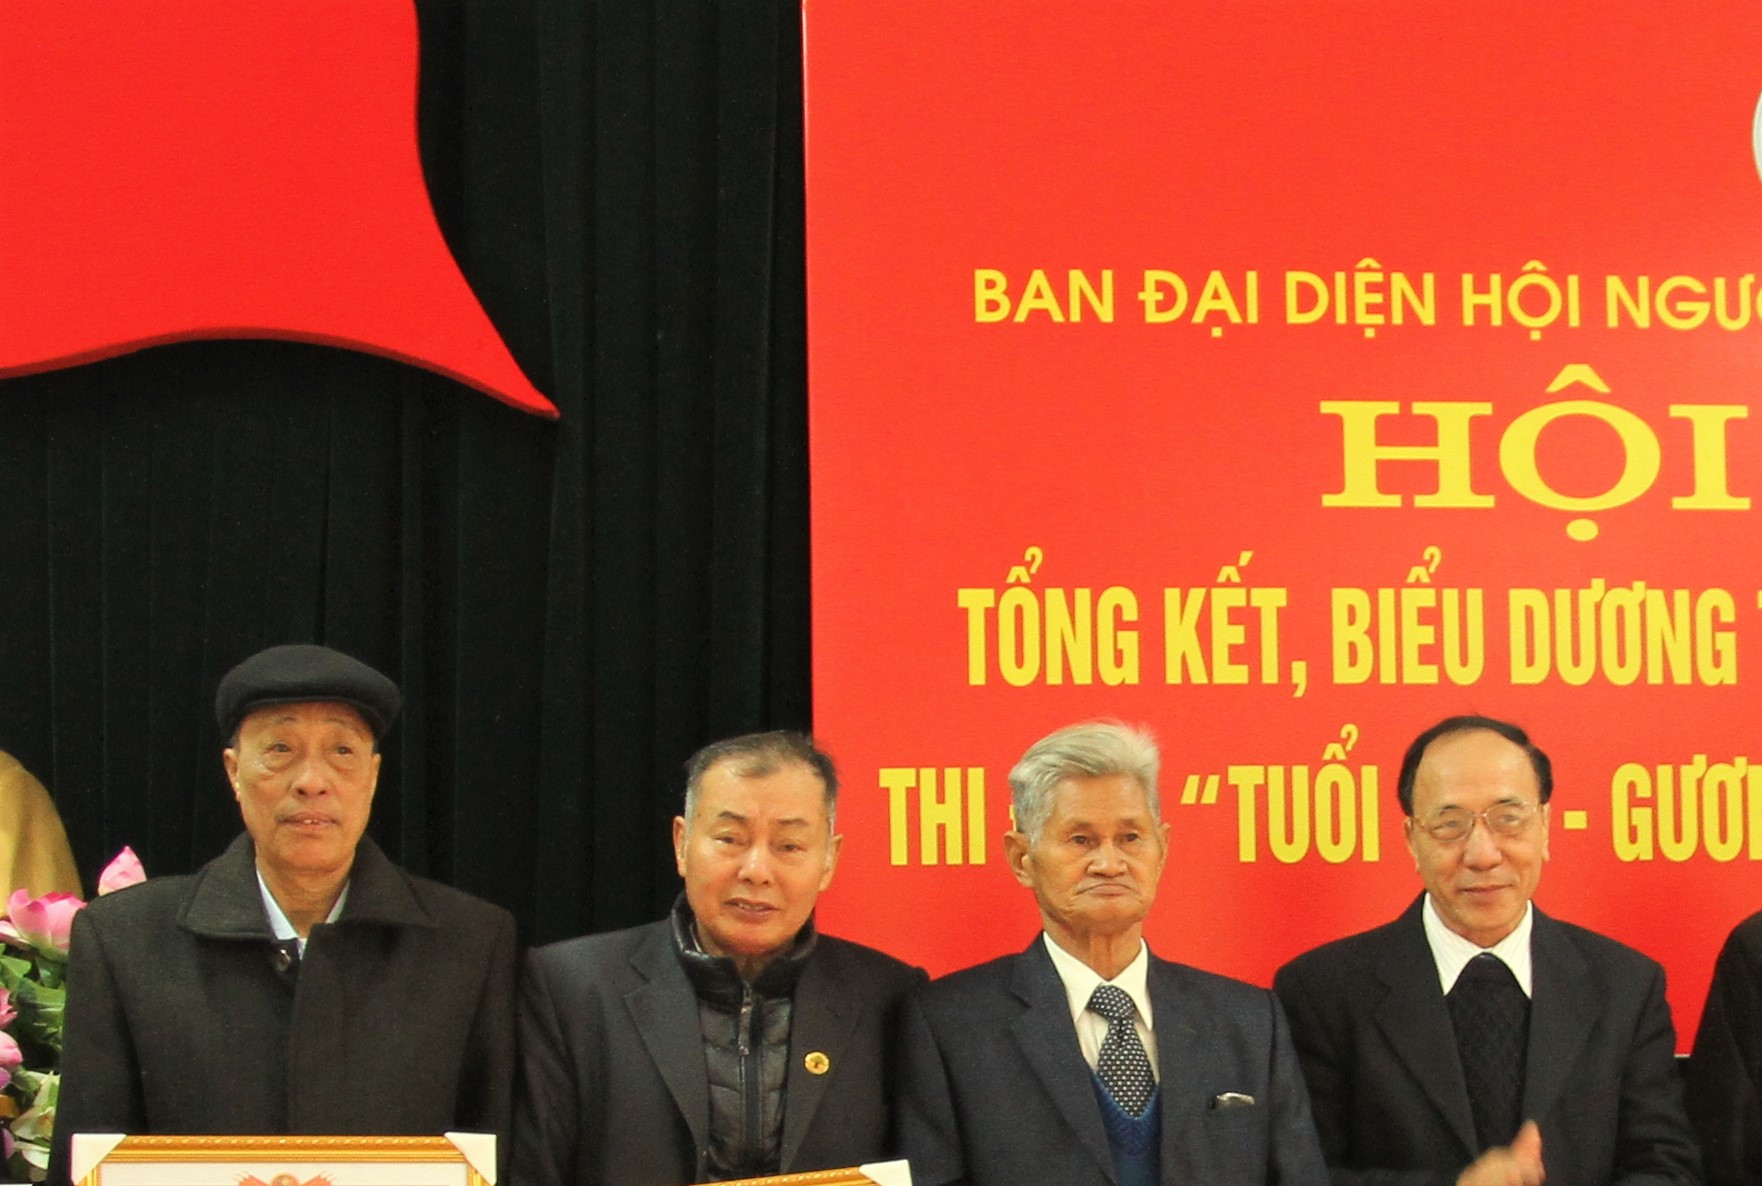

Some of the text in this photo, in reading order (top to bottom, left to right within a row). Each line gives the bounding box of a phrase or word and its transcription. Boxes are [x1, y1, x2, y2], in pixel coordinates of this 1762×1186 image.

[975, 270, 1113, 322] BAN
[1138, 270, 1258, 337] ĐẠI
[1286, 258, 1435, 338] DIỆN
[1462, 261, 1580, 340] HỘI
[1320, 364, 1751, 542] HỘI
[958, 547, 1139, 686] TỔNG
[1164, 551, 1307, 697] KẾT,
[1332, 546, 1484, 685] BIỂU
[1509, 578, 1737, 686] DƯƠNG
[879, 768, 985, 865] THI
